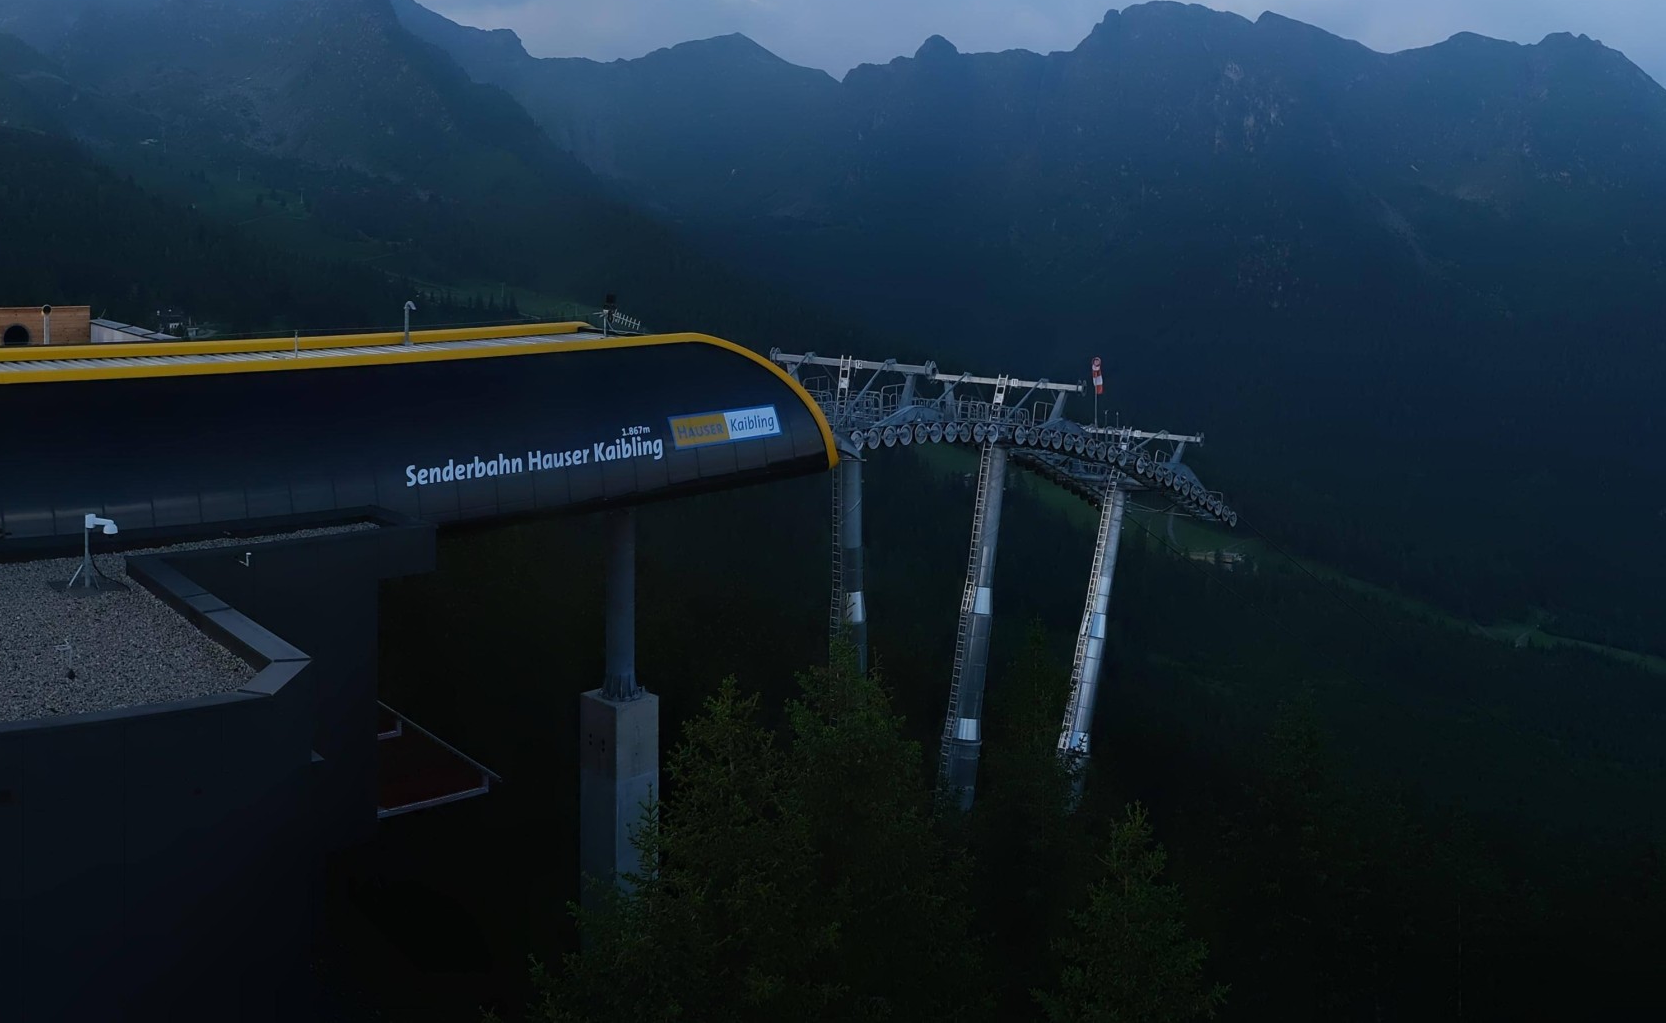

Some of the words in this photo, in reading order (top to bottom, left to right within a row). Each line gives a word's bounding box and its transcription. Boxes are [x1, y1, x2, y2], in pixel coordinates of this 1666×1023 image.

[621, 426, 651, 436] 1.867m
[677, 423, 724, 439] HAUSER
[730, 415, 775, 432] Kaibling
[405, 453, 523, 487] Senderbahn
[528, 448, 590, 472] Hauser
[594, 436, 664, 462] Kaibling
